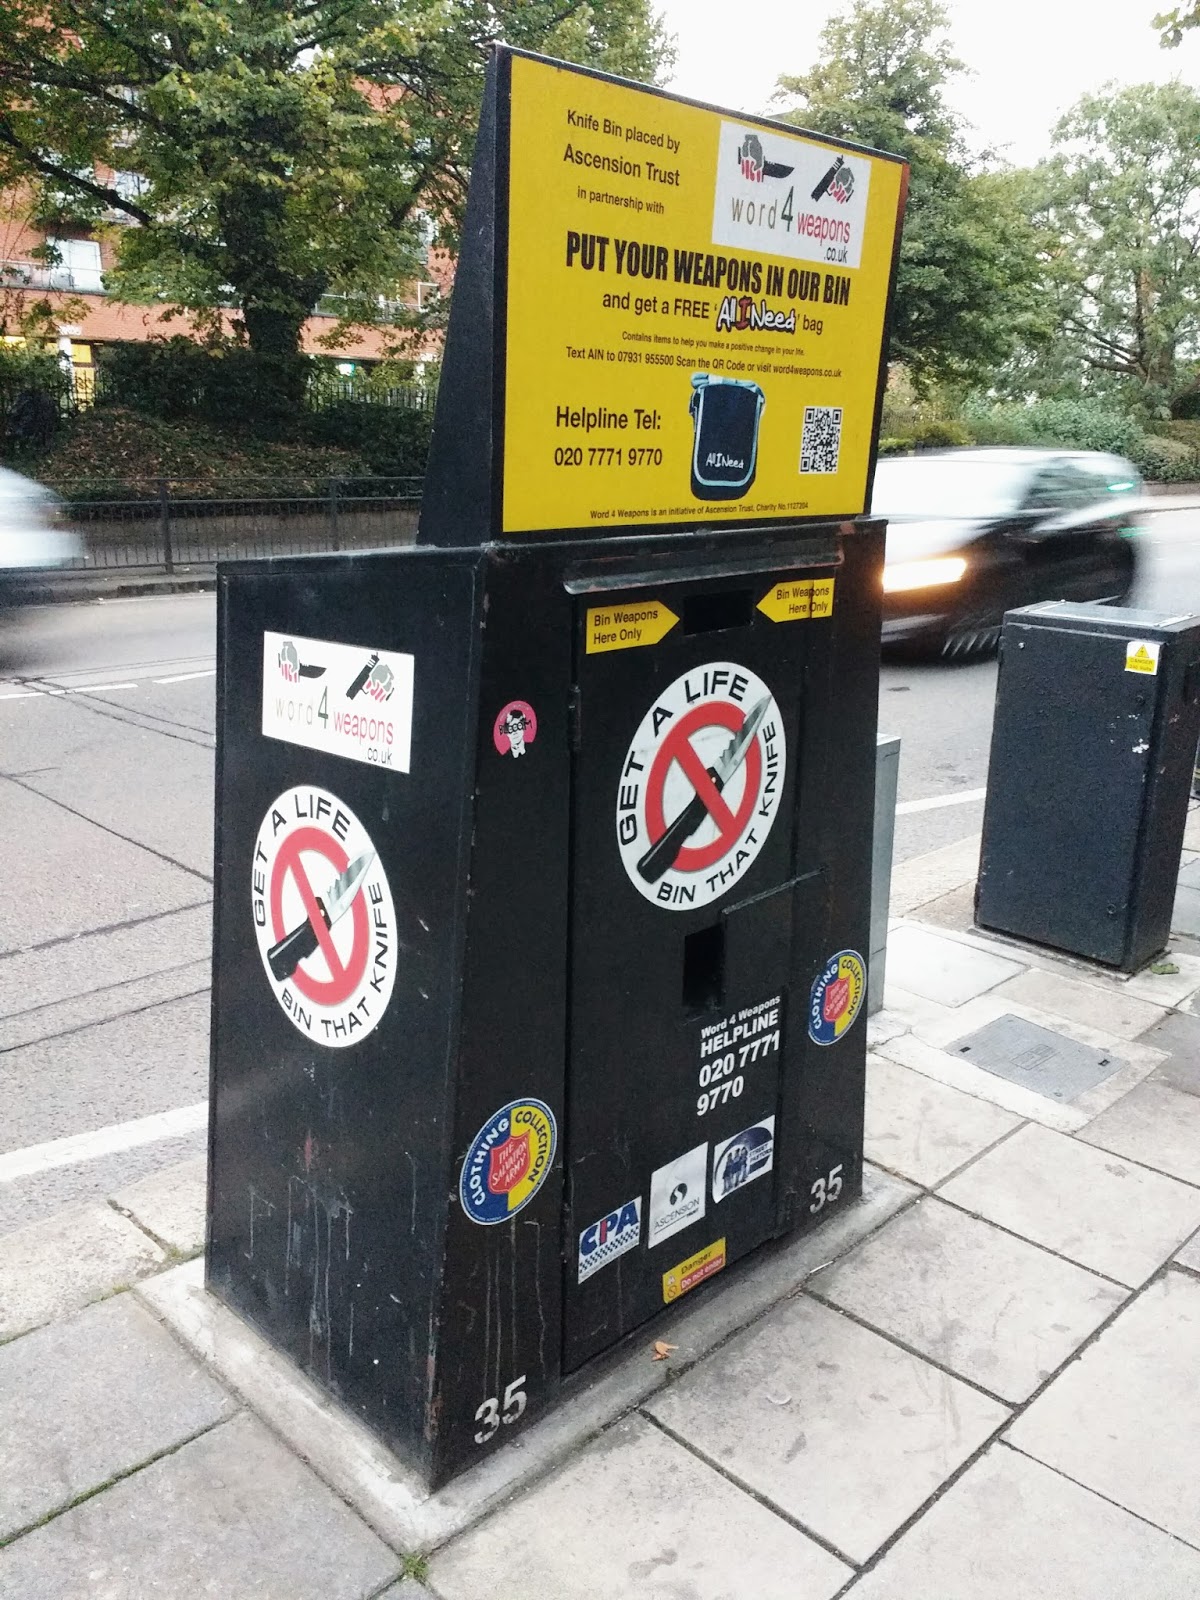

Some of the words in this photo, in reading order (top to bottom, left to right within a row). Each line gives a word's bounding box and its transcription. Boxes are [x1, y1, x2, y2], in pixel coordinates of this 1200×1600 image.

[567, 109, 599, 132] Knife
[603, 117, 622, 135] Bin
[625, 122, 664, 148] placed
[667, 132, 680, 153] by
[563, 143, 641, 178] Ascension
[645, 161, 680, 187] Trust
[577, 186, 587, 199] in
[589, 191, 644, 212] partnership
[646, 198, 665, 214] with
[732, 197, 776, 230] word
[781, 186, 794, 232] 4
[797, 212, 850, 247] weapons
[566, 230, 610, 272] PUT
[614, 238, 669, 280] YOUR
[673, 249, 762, 295] WEAPONS
[766, 264, 784, 298] IN
[787, 267, 819, 302] OUR
[823, 273, 851, 306] BIN
[823, 245, 848, 263] .co.uk
[602, 292, 630, 311] and
[634, 295, 657, 316] get
[661, 300, 669, 314] a
[674, 298, 710, 319] FREE
[803, 314, 823, 335] bag
[566, 346, 585, 359] Text
[588, 349, 604, 360] AIN
[607, 351, 615, 361] to
[618, 351, 642, 363] 07931
[645, 354, 674, 365] 955500
[676, 356, 695, 367] Scan
[698, 358, 710, 368] the
[712, 358, 724, 369] QR
[726, 360, 745, 370] Code
[747, 364, 754, 372] or
[757, 363, 771, 373] visit
[773, 364, 842, 378] word4weapons.co.uk
[622, 331, 652, 342] Contains
[654, 334, 671, 344] items
[673, 336, 679, 344] to
[681, 337, 694, 346] help
[709, 341, 724, 349] make
[731, 342, 753, 351] positive
[754, 344, 774, 354] change
[782, 347, 794, 355] your
[556, 406, 628, 432] Helpline
[633, 409, 661, 430] Tel:
[554, 447, 583, 466] 020
[588, 447, 625, 467] 7771
[628, 447, 662, 467] 9770
[590, 510, 609, 518] Word
[617, 509, 649, 518] Weapons
[651, 508, 656, 516] is
[659, 508, 666, 516] an
[668, 507, 696, 515] initiative
[697, 506, 704, 514] of
[756, 503, 776, 512] Charity
[776, 588, 790, 601] Bin
[792, 586, 830, 600] Weapons
[788, 603, 808, 614] Here
[809, 600, 829, 614] Only
[593, 631, 616, 645] Here
[620, 628, 642, 642] Only
[594, 614, 611, 626] Bin
[614, 608, 659, 625] Weapons
[318, 686, 329, 729] 4
[334, 710, 394, 745] weapons
[365, 747, 392, 766] .co.uk
[619, 751, 646, 846] GET
[652, 707, 674, 736] A
[684, 670, 750, 703] LIFE
[657, 881, 697, 904] BIN
[706, 828, 758, 892] THAT
[759, 722, 778, 817] KNIFE
[254, 842, 269, 927] GET
[271, 808, 288, 836] A
[294, 794, 352, 842] LIFE
[281, 988, 313, 1031] BIN
[321, 998, 371, 1039] THAT
[370, 882, 388, 994] KNIFE
[812, 964, 838, 1029] CLOTHING
[842, 960, 860, 1016] COLLECTION
[700, 1008, 779, 1058] HELPLINE
[701, 1018, 727, 1039] Word
[729, 1014, 736, 1025] 4
[738, 996, 780, 1021] Weapons
[699, 1053, 735, 1087] 020
[739, 1030, 780, 1068] 7771
[697, 1075, 744, 1116] 9770
[469, 1118, 510, 1206] CLOTHING
[515, 1111, 547, 1182] COLLECTION
[492, 1137, 527, 1186] SALVATION
[499, 1142, 513, 1164] THE
[504, 1153, 526, 1186] ARMY
[809, 1163, 844, 1215] 35
[581, 1201, 639, 1256] CPA
[654, 1197, 700, 1229] ASCENSION
[681, 1251, 712, 1275] Danger
[681, 1278, 692, 1289] Do
[692, 1269, 704, 1282] not
[704, 1258, 722, 1276] enter
[474, 1374, 528, 1445] 35
